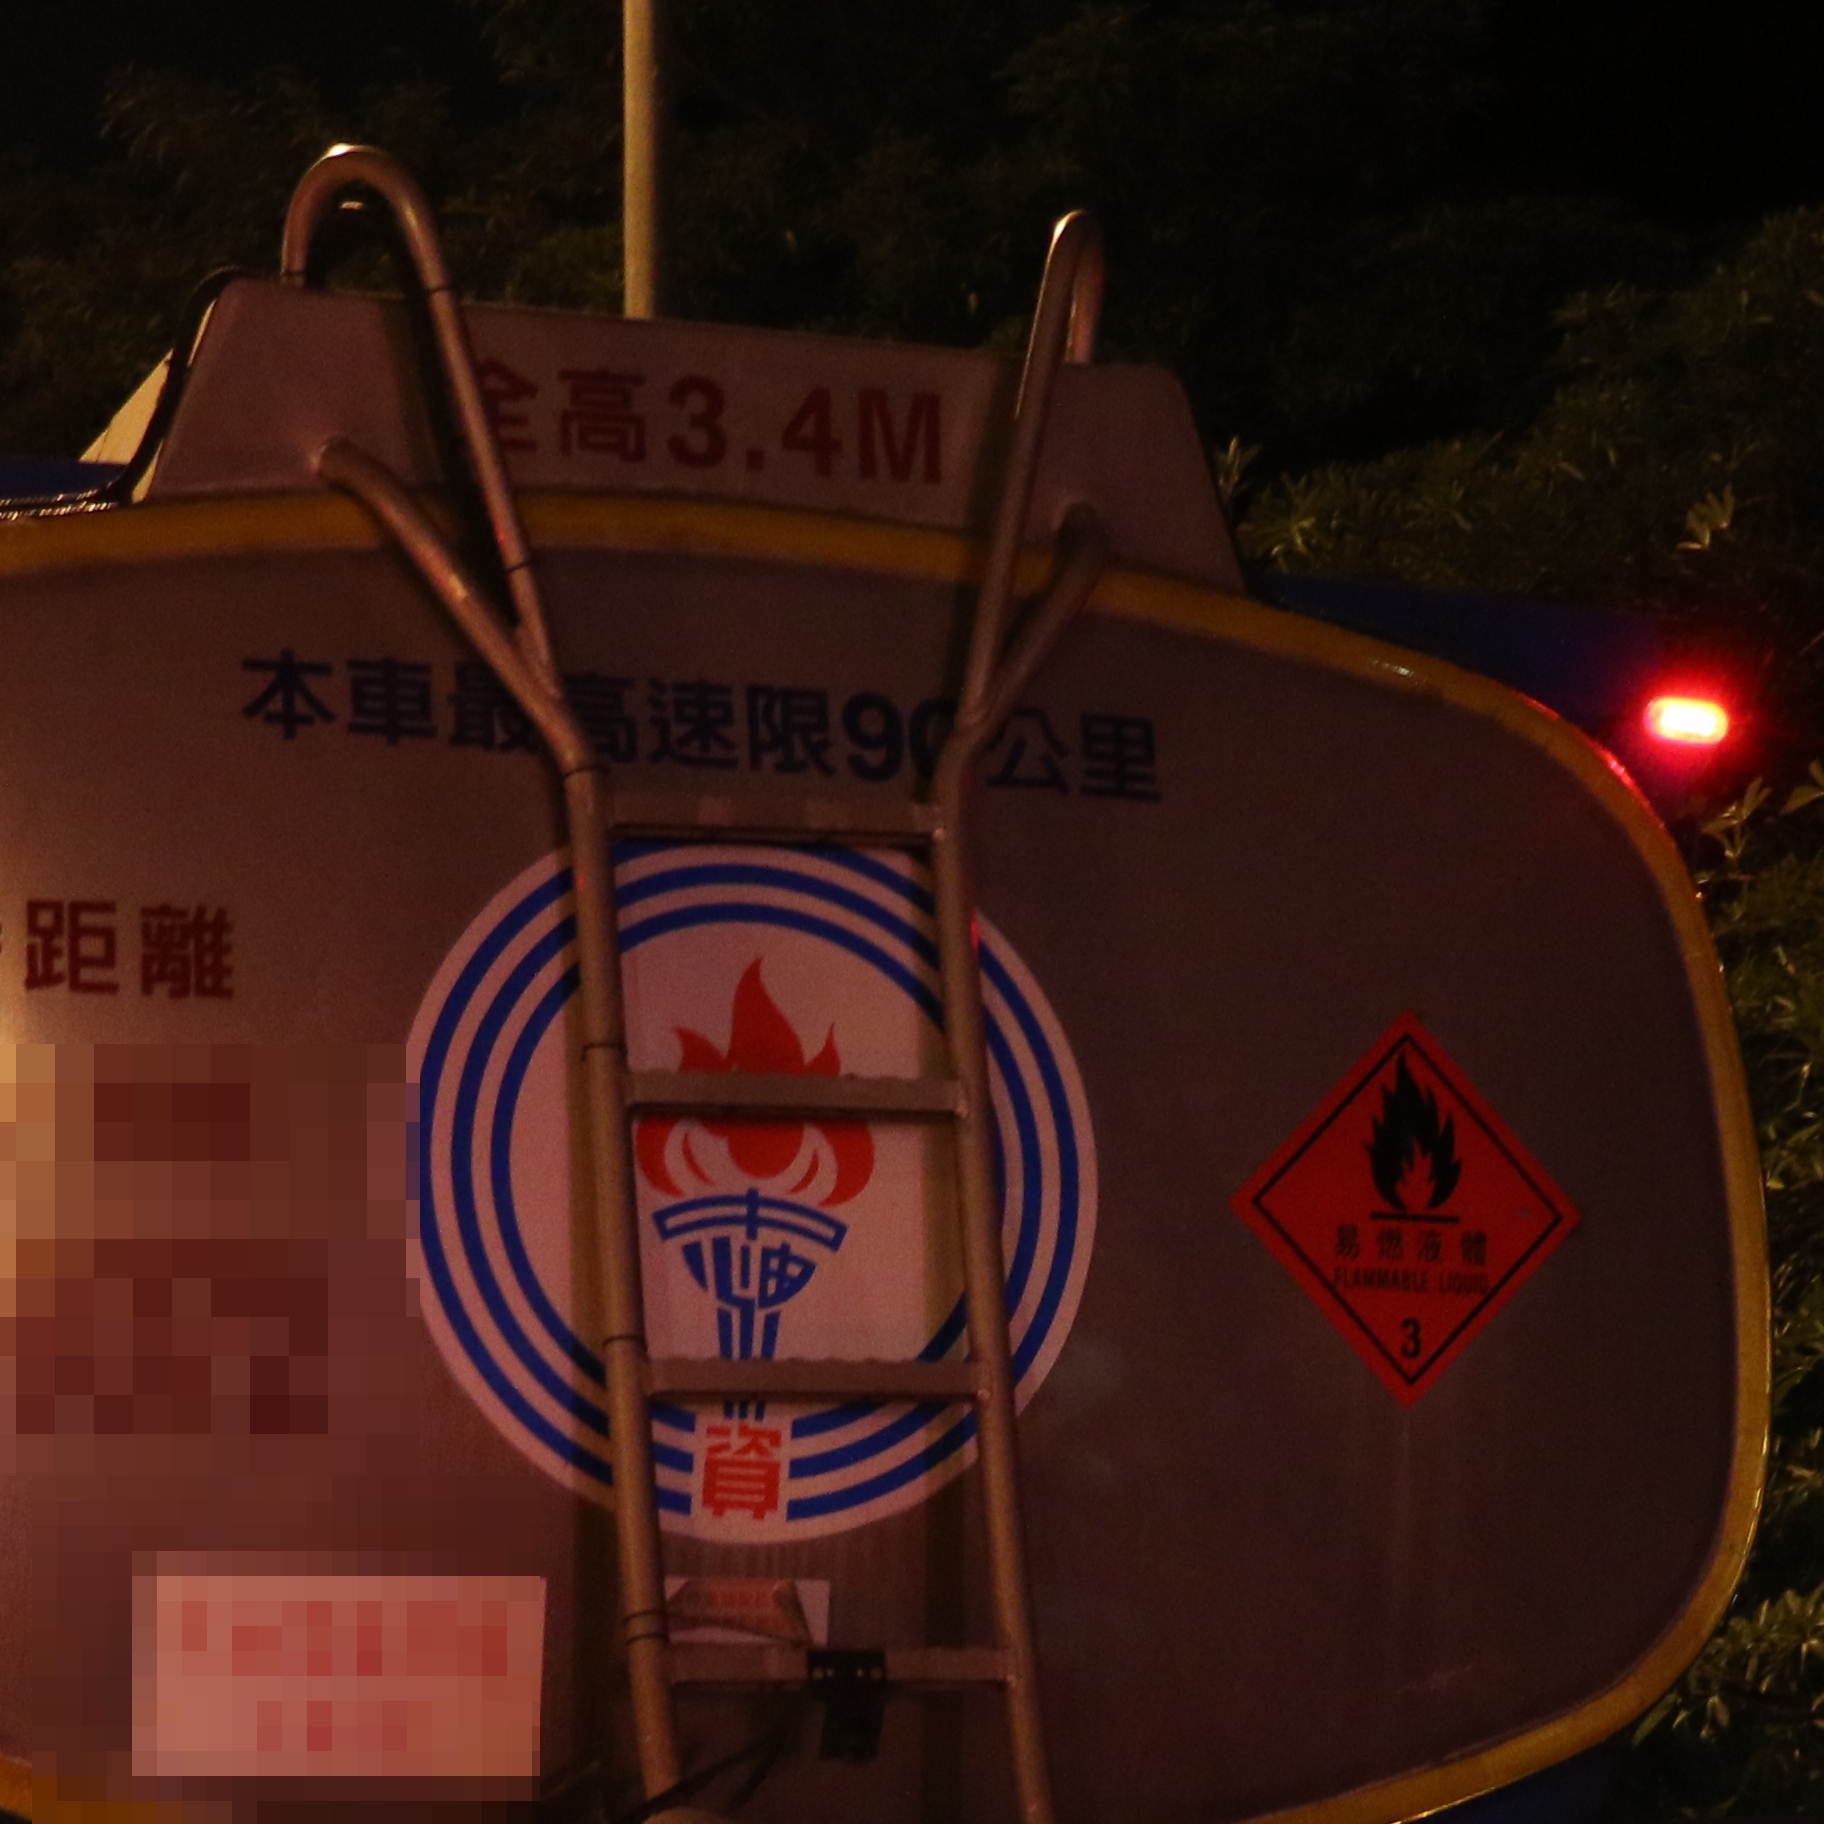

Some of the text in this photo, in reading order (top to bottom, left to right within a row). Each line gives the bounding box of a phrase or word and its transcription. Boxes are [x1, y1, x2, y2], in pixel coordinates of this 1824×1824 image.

[1334, 1265, 1490, 1296] FLAMMABLE LIQUID
[1400, 1317, 1422, 1359] 3
